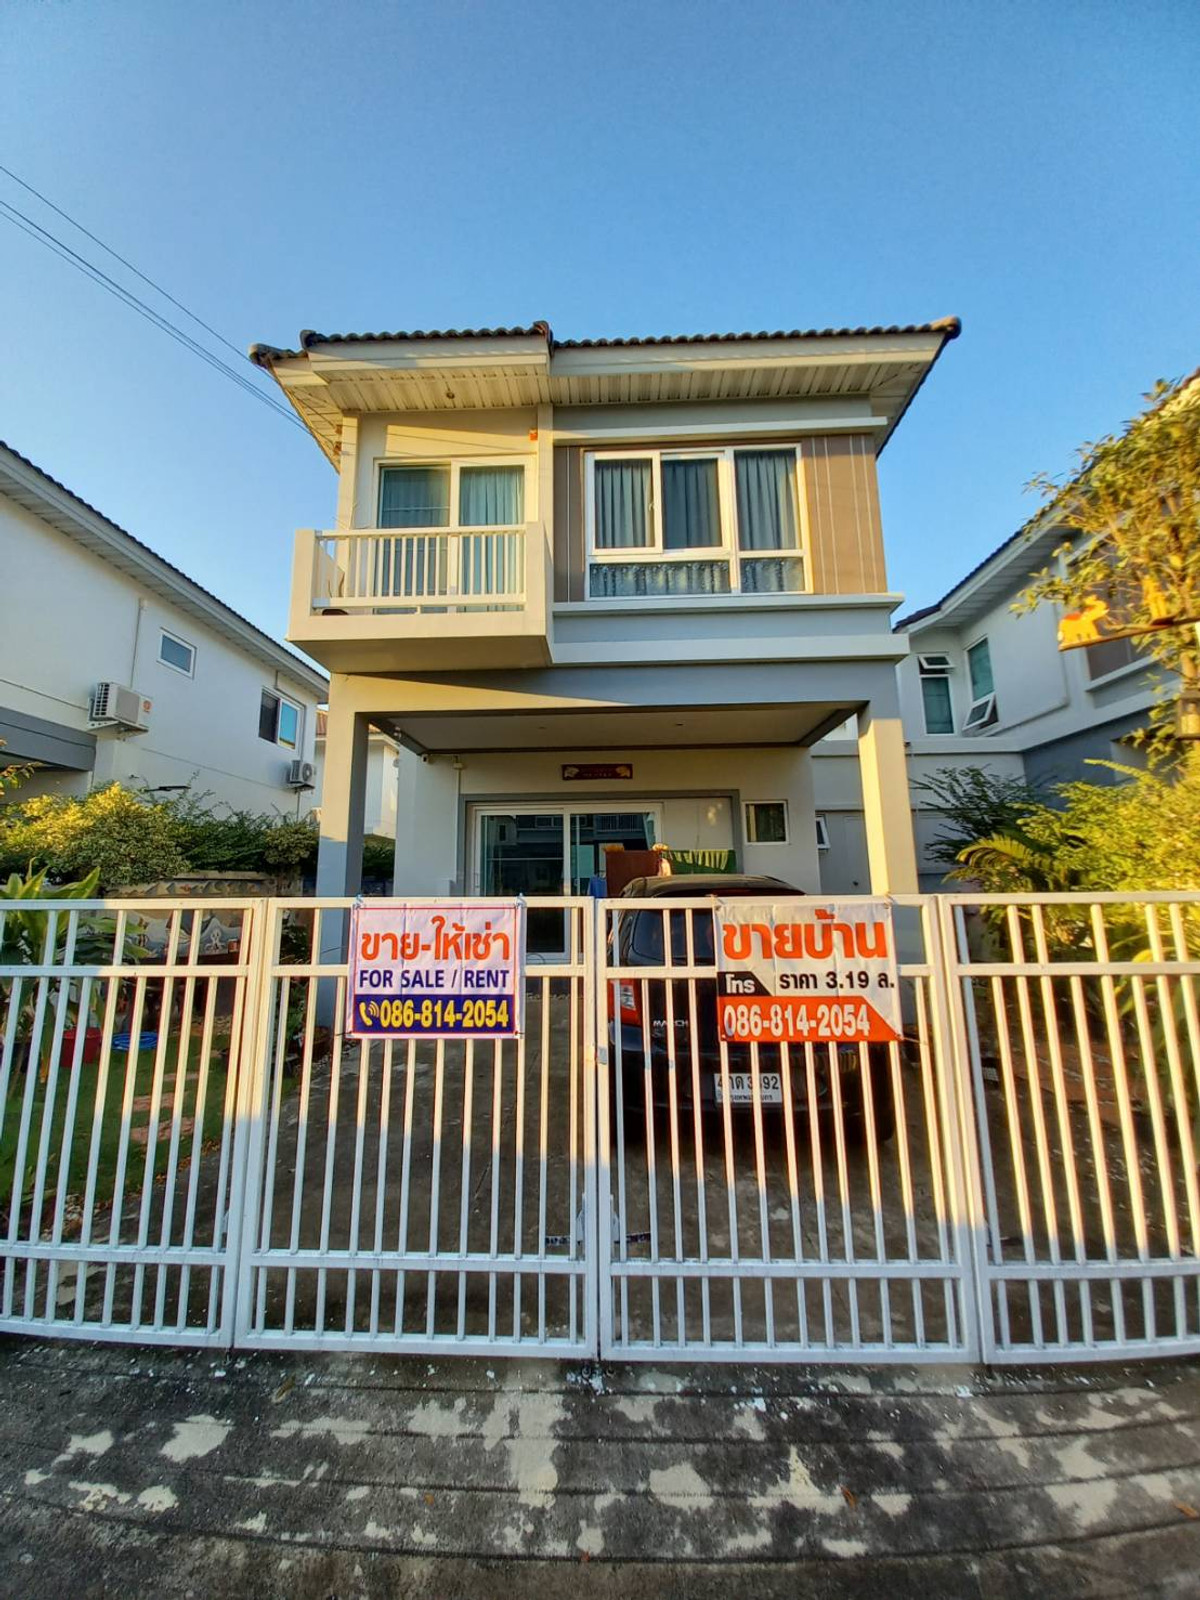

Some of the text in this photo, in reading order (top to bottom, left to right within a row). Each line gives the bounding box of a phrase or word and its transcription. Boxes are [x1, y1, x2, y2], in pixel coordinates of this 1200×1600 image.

[361, 915, 510, 961] ขาย-ให้เช่า
[722, 909, 888, 960] ขายบ้าน
[359, 969, 393, 988] FOR
[401, 969, 444, 988] SALE
[464, 969, 509, 988] RENT
[725, 973, 755, 994] โทร
[779, 971, 895, 989] ราคา 3.19 ล.
[380, 999, 509, 1028] 086-814-2054
[724, 1003, 870, 1037] 086-814-2054
[747, 1075, 779, 1090] 392
